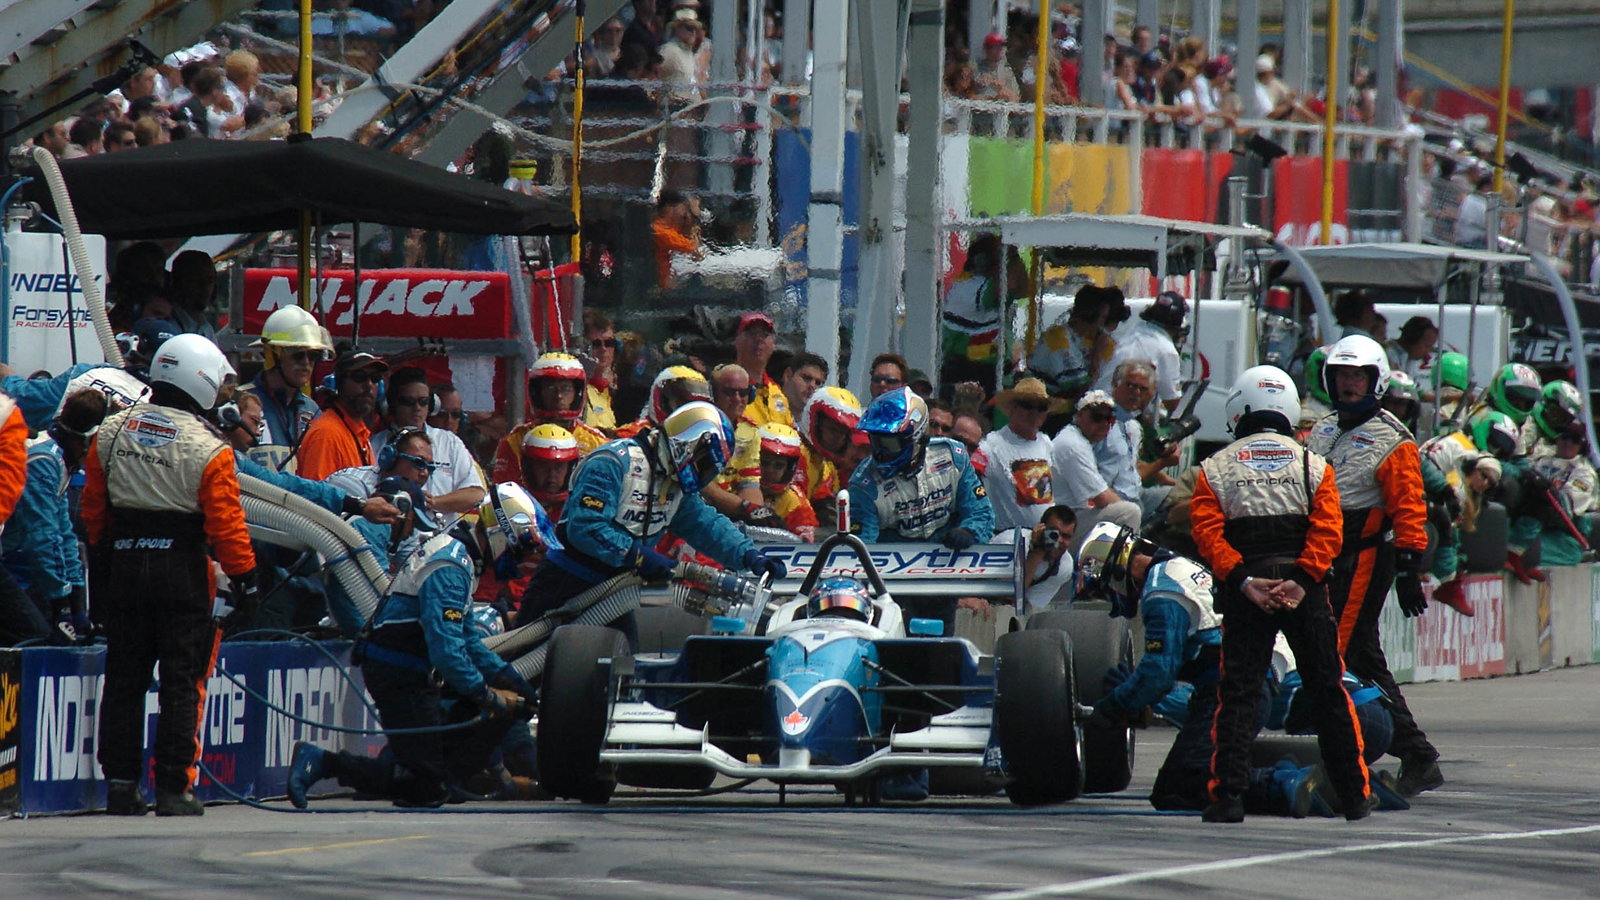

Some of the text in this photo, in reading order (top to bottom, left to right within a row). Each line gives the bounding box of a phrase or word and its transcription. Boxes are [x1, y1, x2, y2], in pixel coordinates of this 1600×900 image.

[11, 273, 102, 293] INDEC
[116, 449, 173, 468] OFFICIAL
[1236, 476, 1301, 488] OFFICIAL
[758, 546, 1014, 574] Forsythe
[34, 674, 106, 781] INDEC
[265, 666, 350, 768] INDECK
